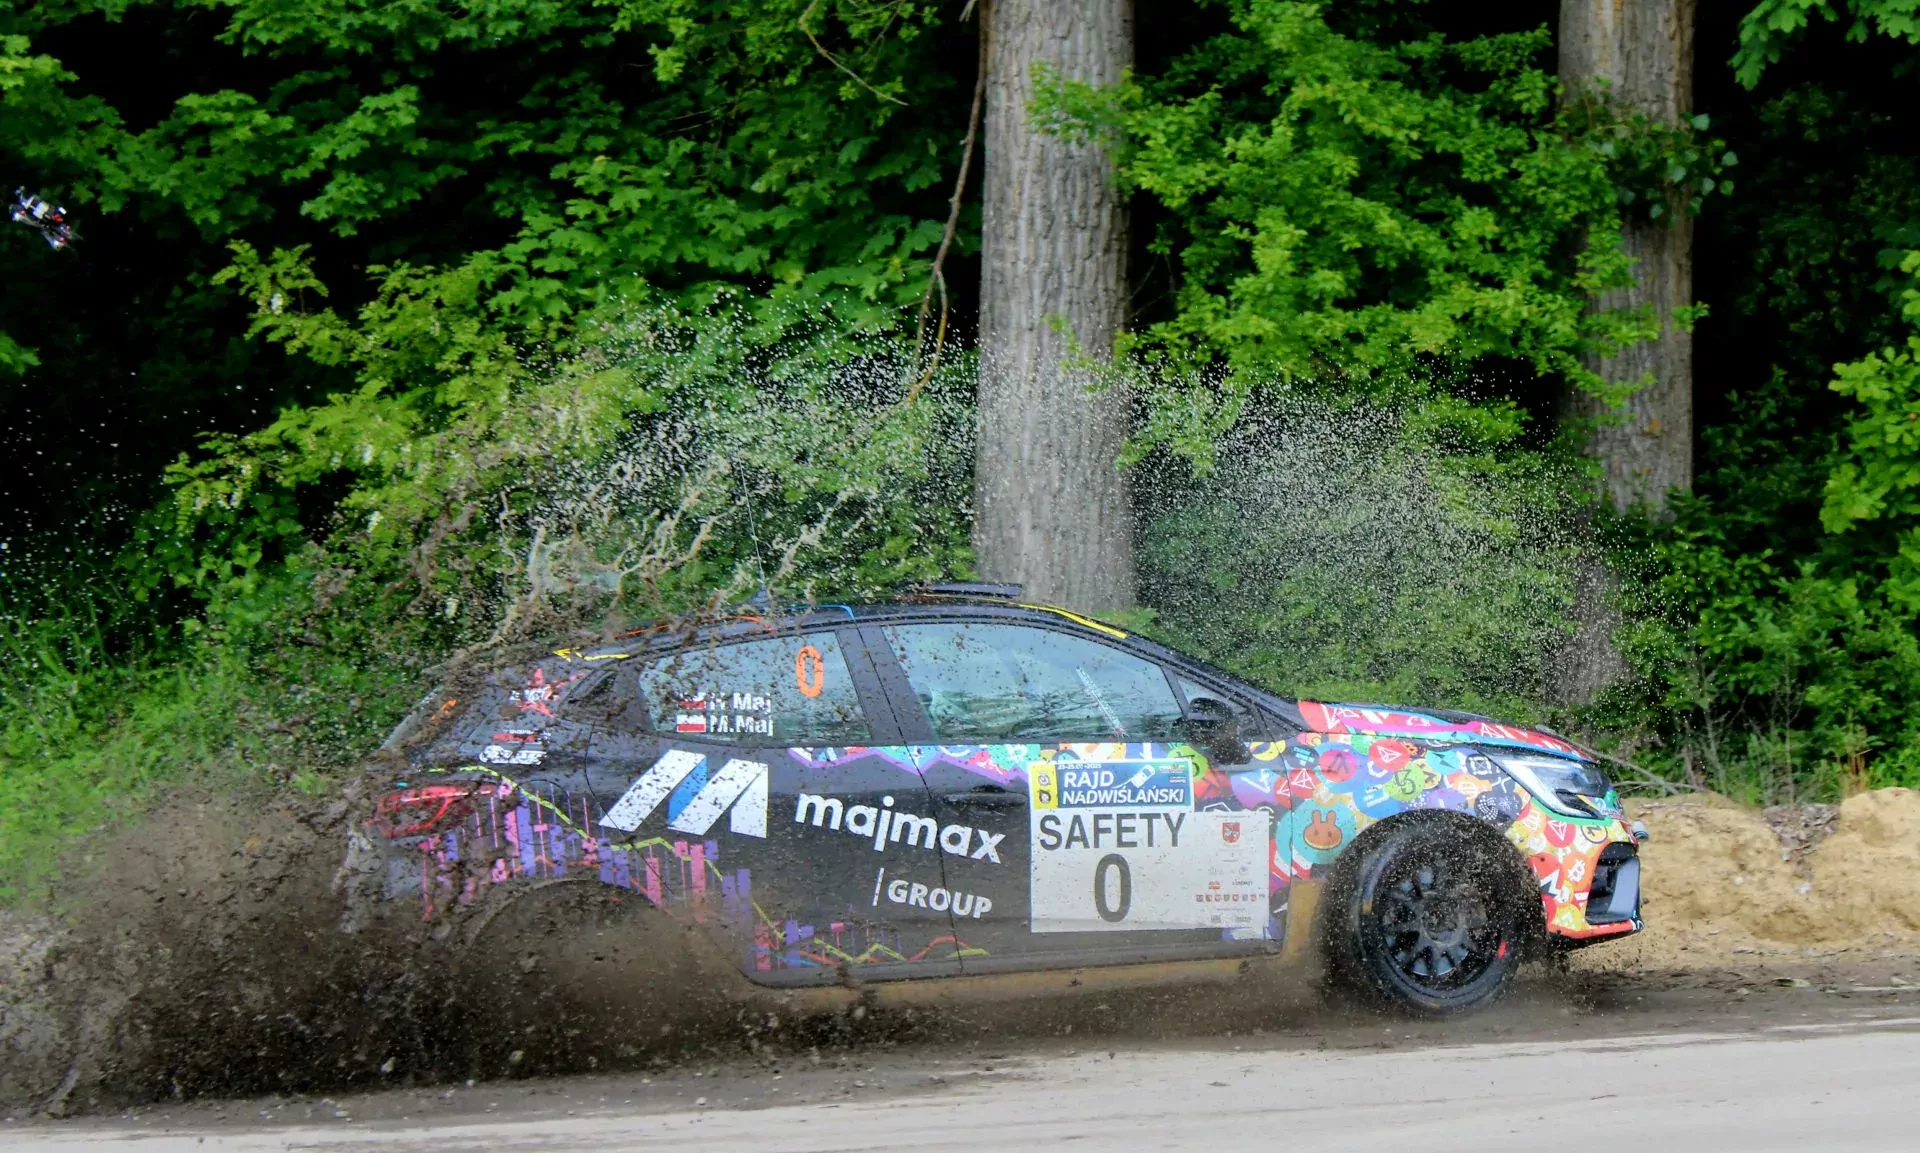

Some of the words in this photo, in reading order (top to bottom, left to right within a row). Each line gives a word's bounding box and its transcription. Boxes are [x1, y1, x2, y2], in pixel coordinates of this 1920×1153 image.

[796, 645, 824, 698] 0
[1062, 785, 1185, 805] NADWIŚLAŃSKI
[1063, 771, 1114, 789] RAJD
[794, 792, 1006, 864] majmax
[1039, 812, 1186, 850] SAFETY
[887, 879, 993, 919] GROUP
[1094, 853, 1132, 923] 0
